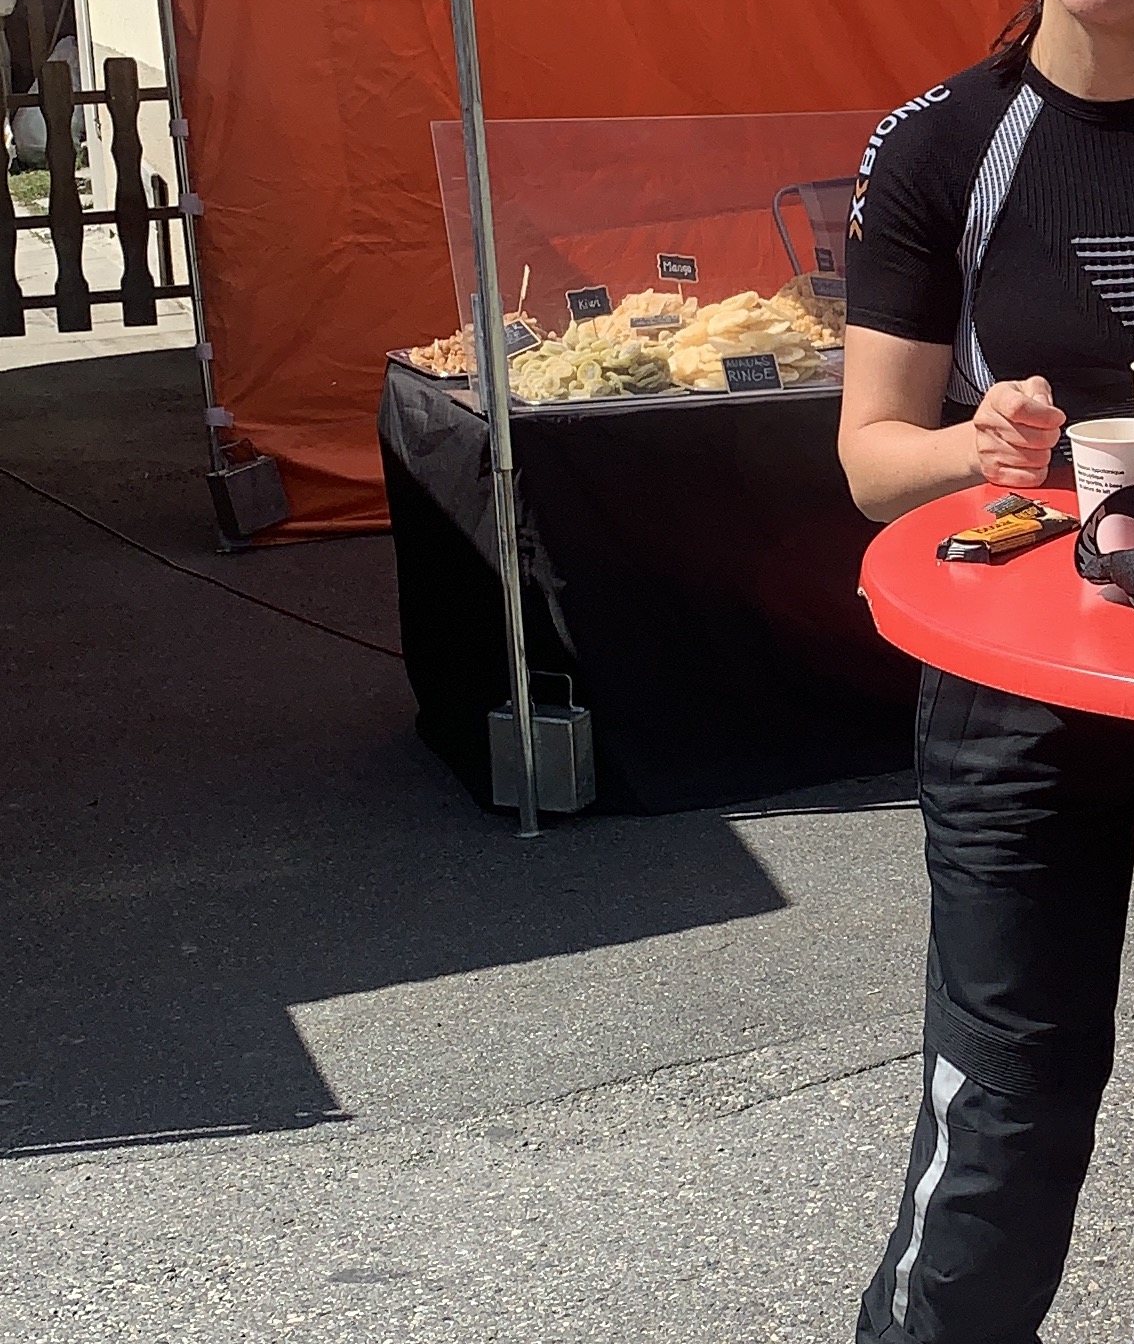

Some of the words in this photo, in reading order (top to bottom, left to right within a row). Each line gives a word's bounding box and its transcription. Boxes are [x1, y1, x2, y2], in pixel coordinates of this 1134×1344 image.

[662, 260, 692, 276] Mango
[578, 296, 601, 310] Kiwi
[728, 367, 776, 382] RINGE
